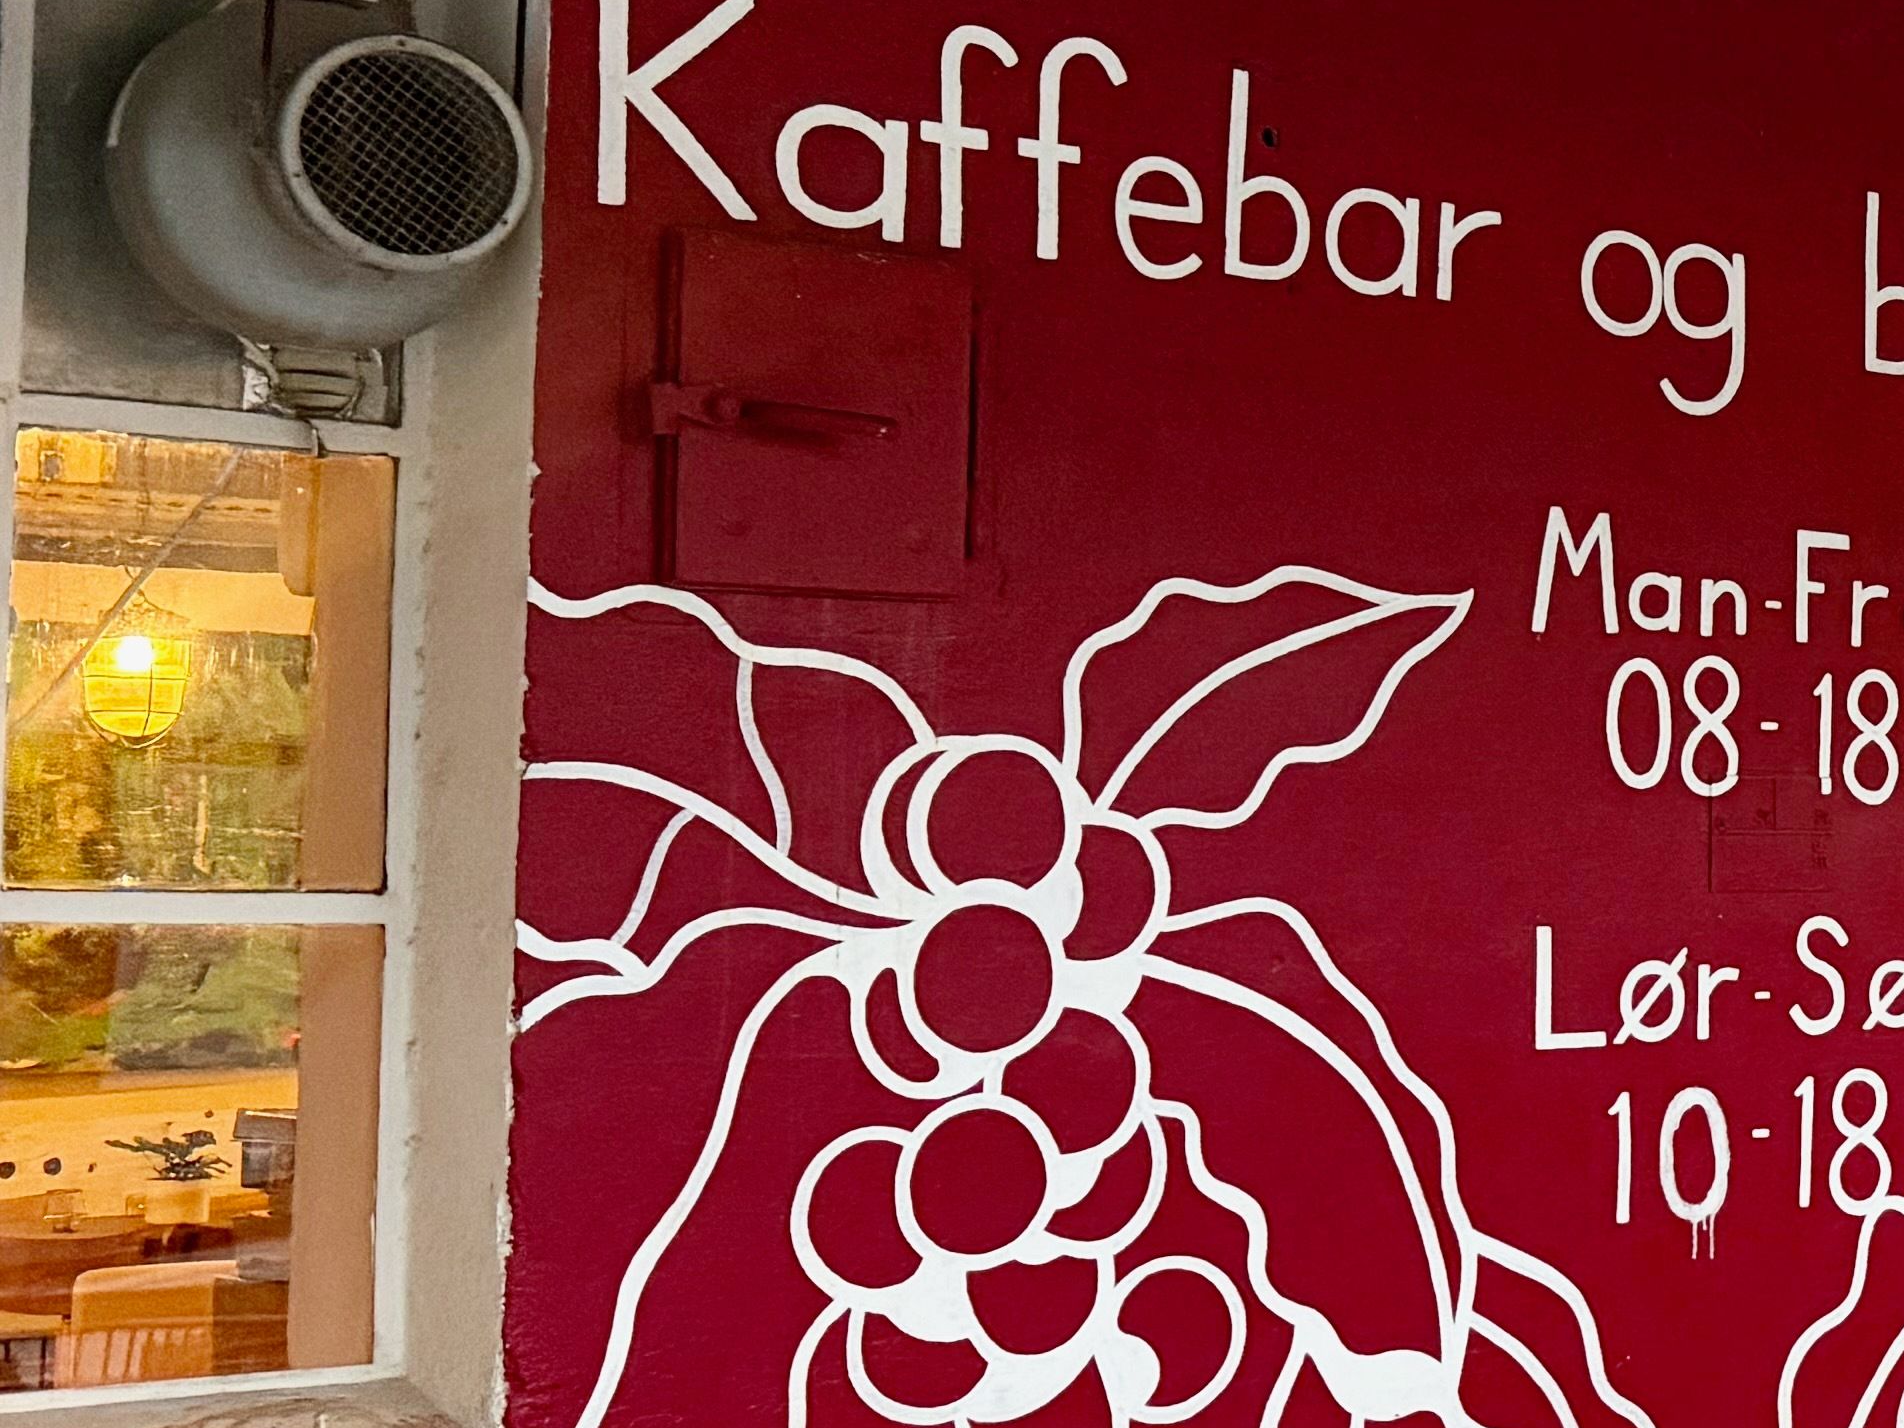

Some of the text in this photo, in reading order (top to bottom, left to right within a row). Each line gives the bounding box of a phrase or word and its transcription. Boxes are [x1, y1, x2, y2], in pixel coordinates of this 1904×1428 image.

[1581, 230, 1746, 416] og
[1606, 655, 1899, 806] 08-18
[1607, 1066, 1893, 1225] 10-18
